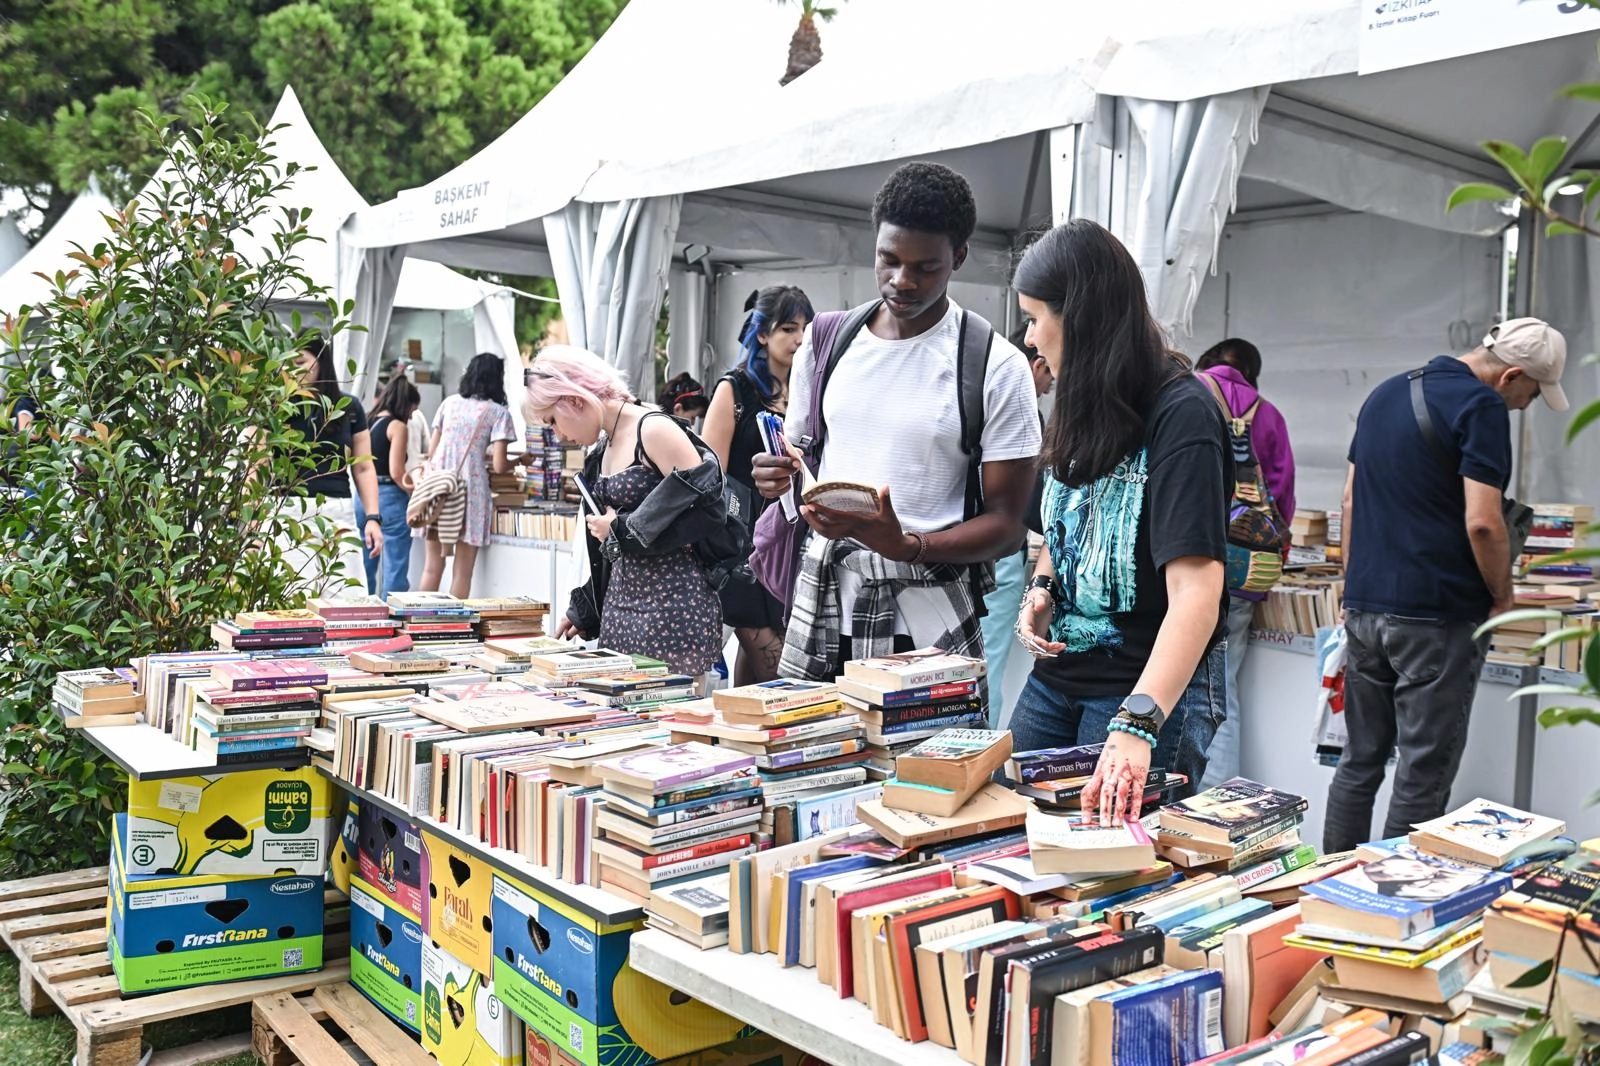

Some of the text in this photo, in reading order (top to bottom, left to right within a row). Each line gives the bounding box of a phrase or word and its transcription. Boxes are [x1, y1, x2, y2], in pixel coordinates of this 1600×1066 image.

[435, 181, 490, 206] BAŞKENT
[440, 207, 478, 228] SAHAF
[1249, 630, 1294, 645] SARAY
[941, 703, 967, 714] MORGAN
[1047, 760, 1093, 774] Thomas Perry
[268, 791, 308, 805] Banini
[138, 848, 148, 862] E
[657, 869, 672, 878] JOHN
[1251, 865, 1275, 880] CROSS
[490, 998, 497, 1015] E
